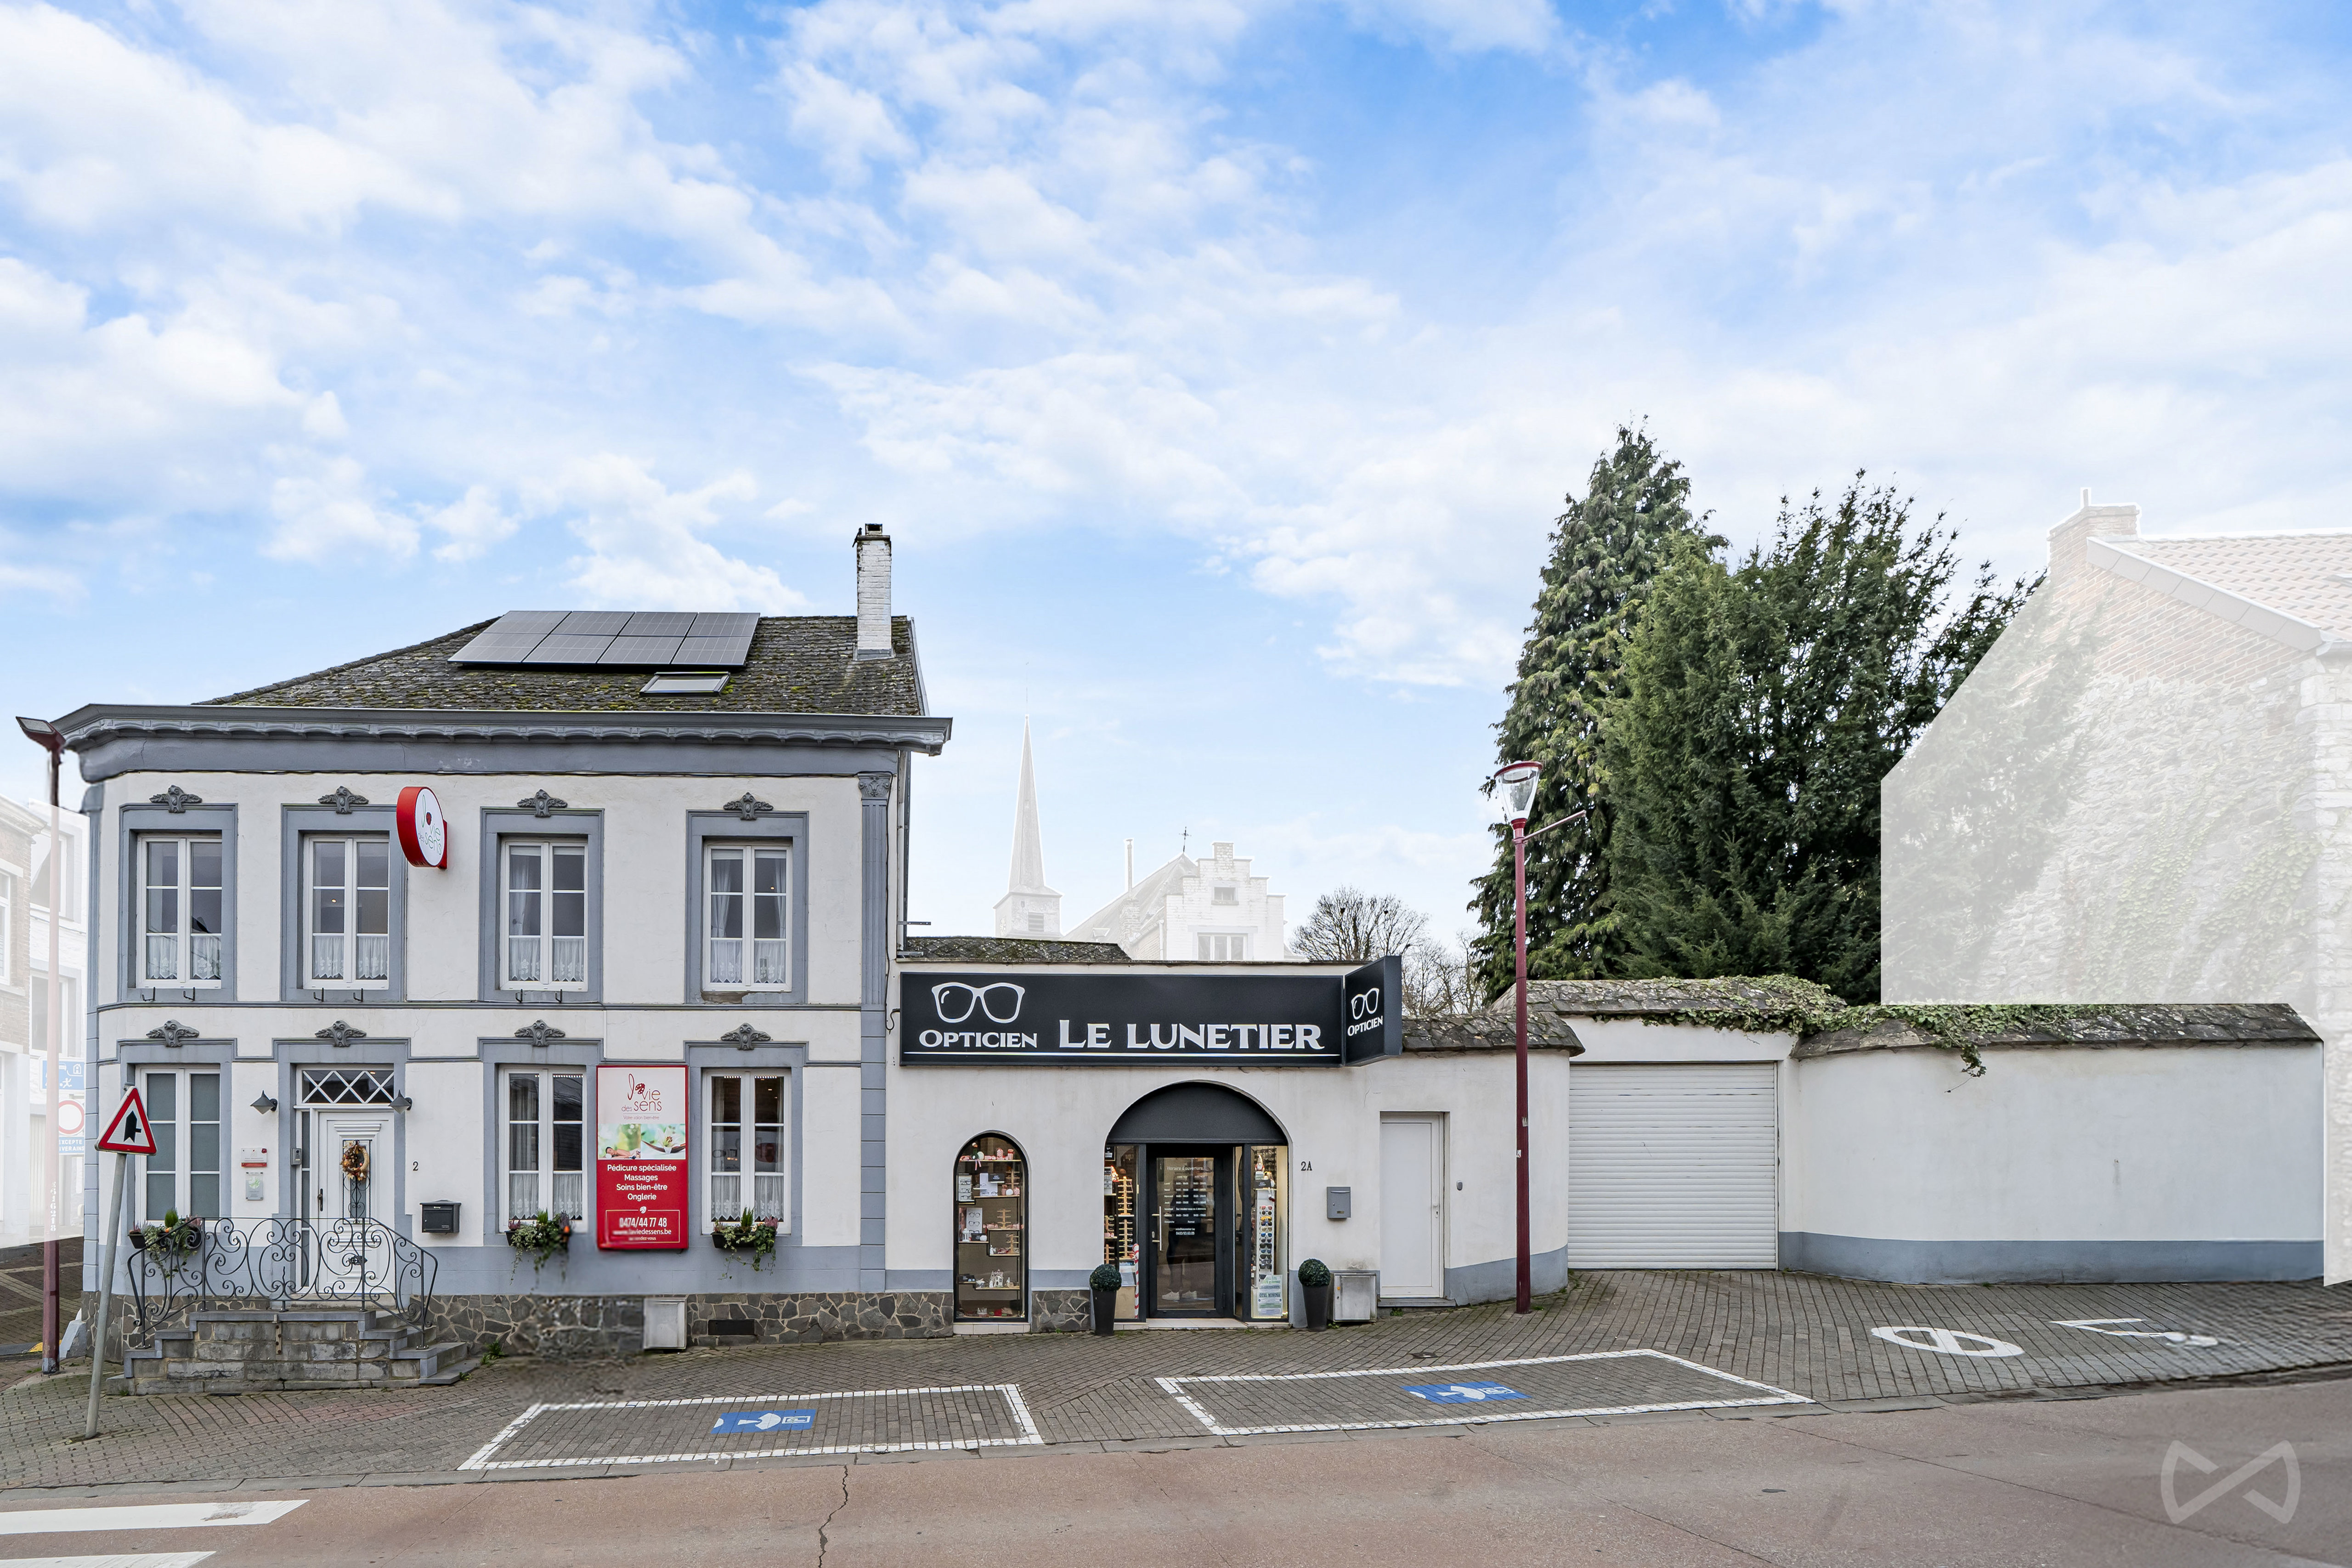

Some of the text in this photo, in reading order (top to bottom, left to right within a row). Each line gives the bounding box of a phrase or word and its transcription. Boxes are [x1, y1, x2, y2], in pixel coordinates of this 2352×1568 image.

[425, 832, 442, 855] sens
[1347, 1015, 1383, 1036] OPTICIEN
[919, 1029, 1037, 1048] OPTICIEN
[1058, 1019, 1325, 1049] LE LUNETIER
[633, 1101, 662, 1111] sens
[413, 1161, 418, 1171] 2
[639, 1164, 677, 1172] spécialisée
[1301, 1160, 1312, 1171] 2A
[624, 1174, 658, 1183] Massages
[628, 1193, 657, 1201] Onglerie
[619, 1217, 667, 1228] 0474/44 77 48
